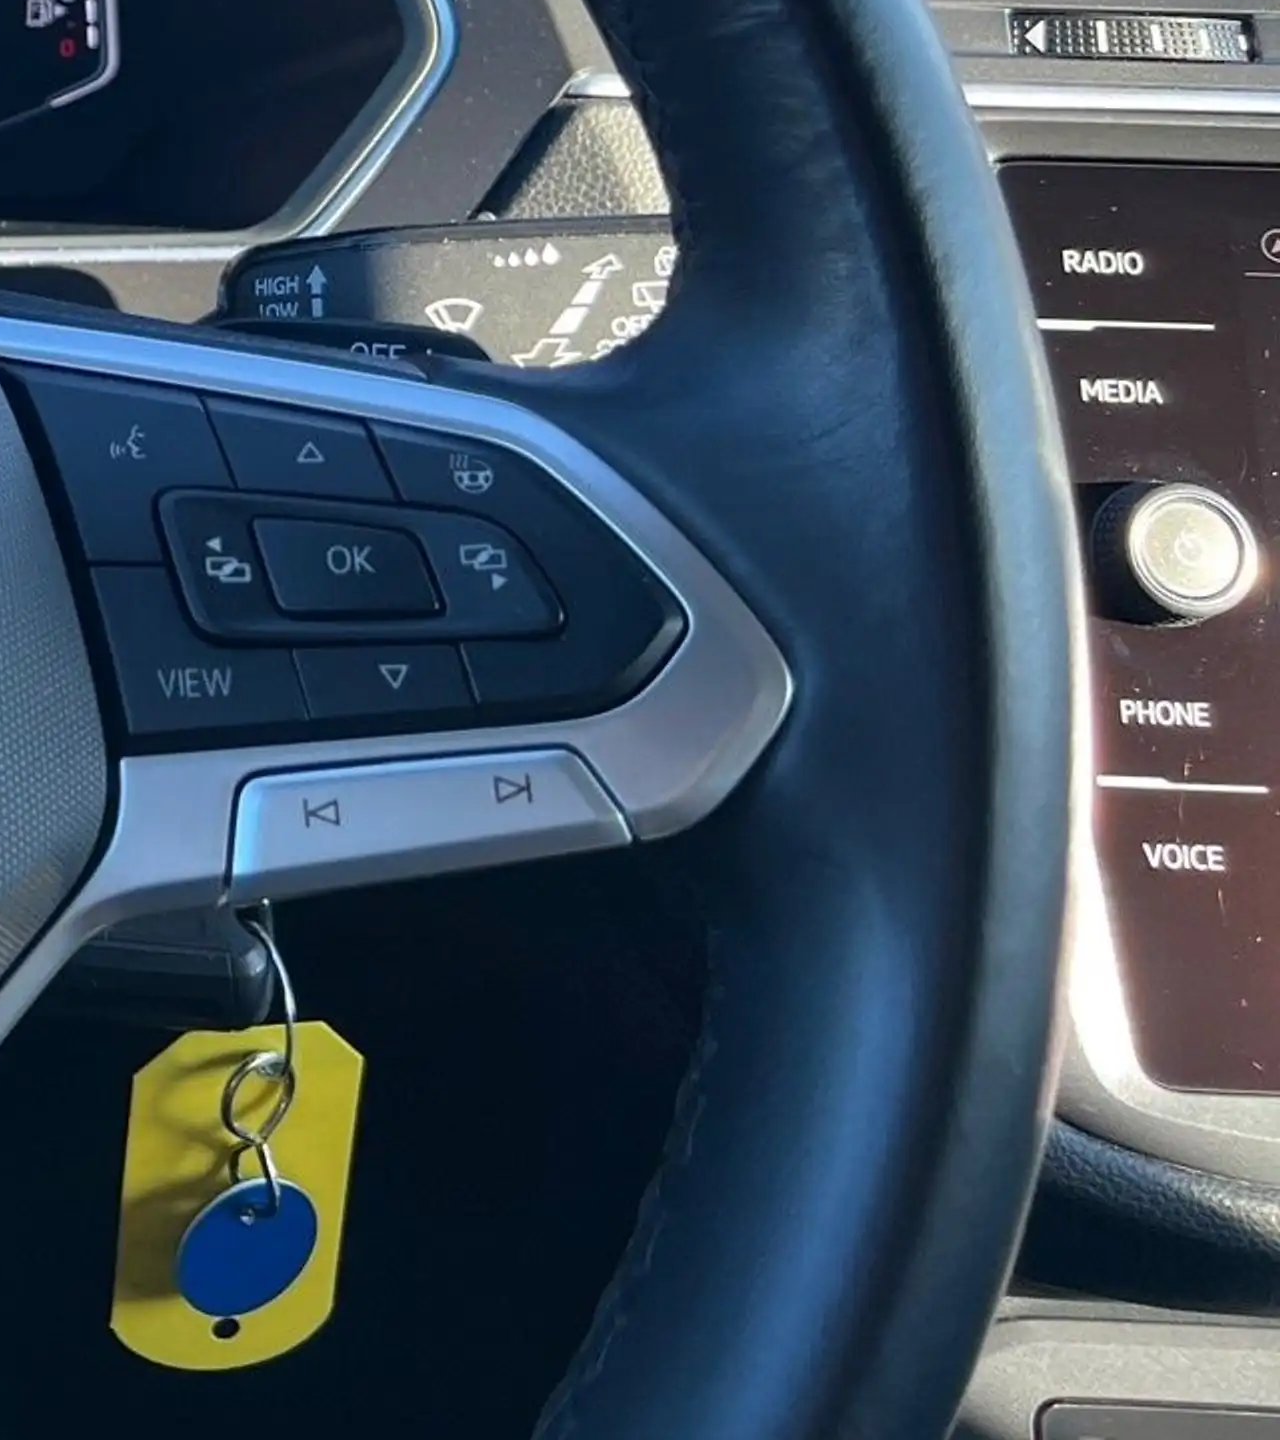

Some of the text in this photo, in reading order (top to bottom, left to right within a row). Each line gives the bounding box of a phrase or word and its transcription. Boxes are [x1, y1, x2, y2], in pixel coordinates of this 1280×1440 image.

[59, 39, 76, 58] 0
[1061, 248, 1145, 277] RADIO
[254, 274, 300, 297] HIGH
[1080, 378, 1164, 407] MEDIA
[326, 544, 374, 576] OK
[156, 666, 233, 700] VIEW
[1118, 697, 1212, 729] PHONE
[1142, 841, 1226, 873] VOICE
